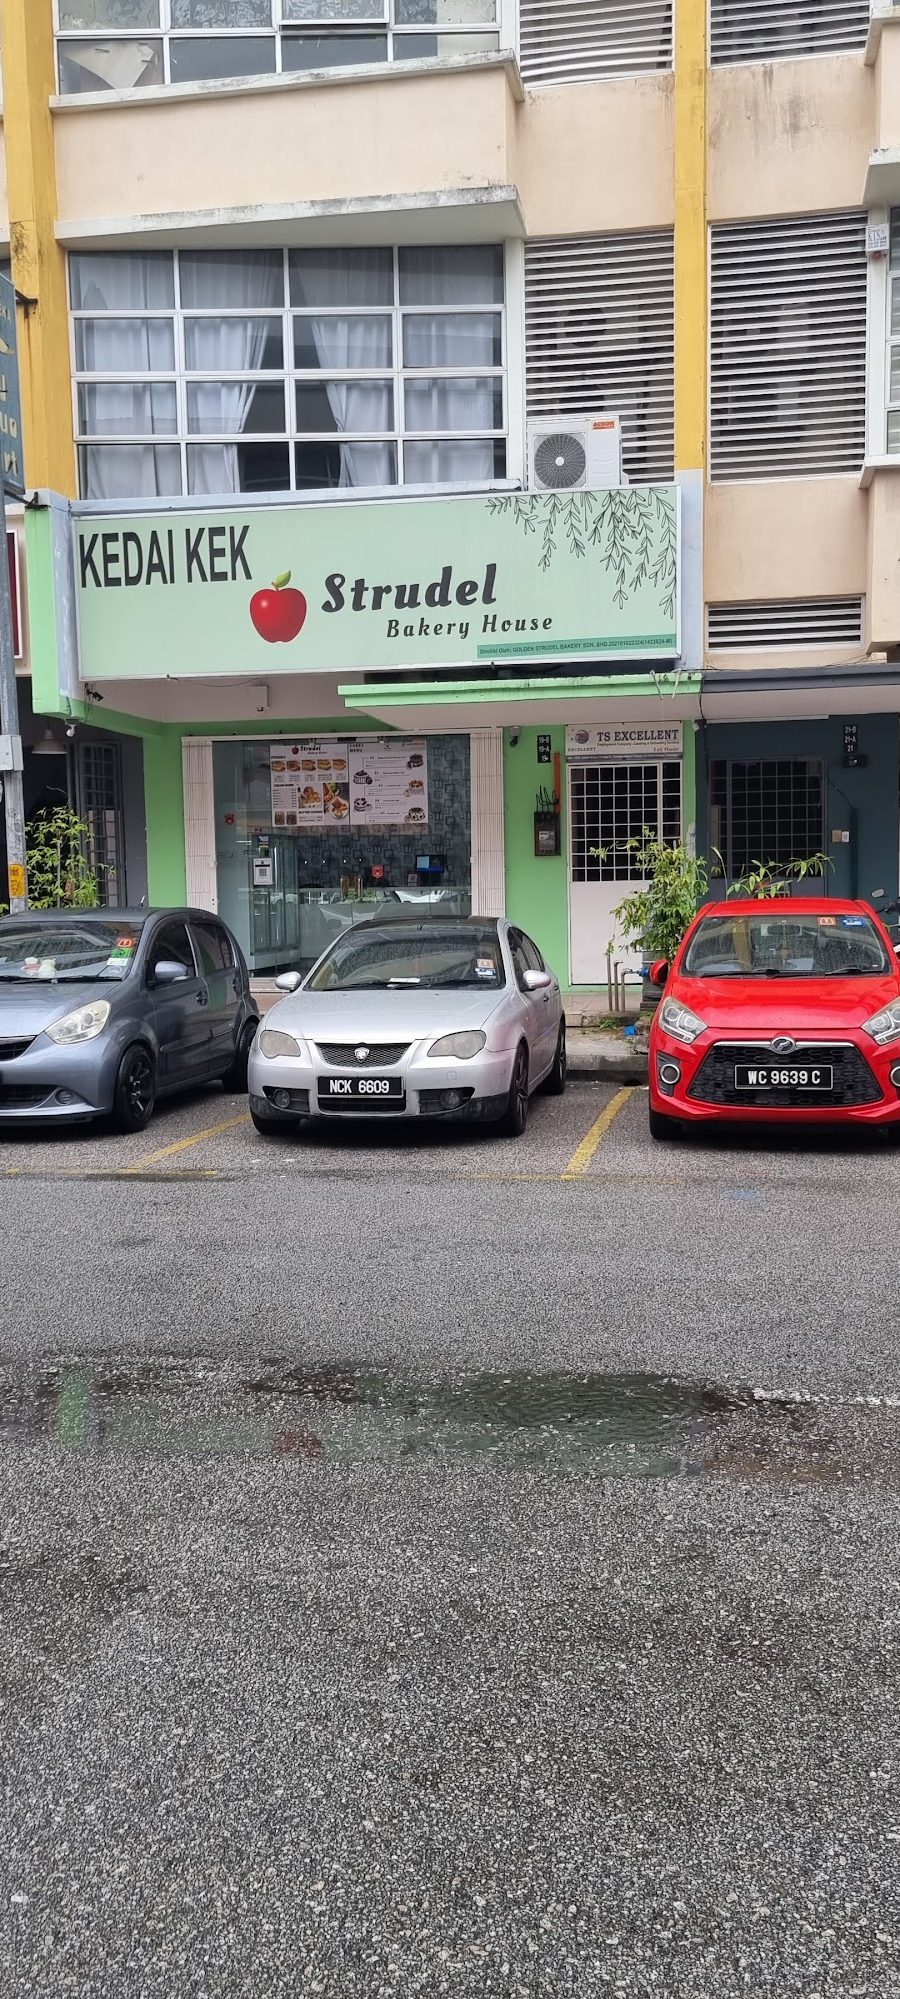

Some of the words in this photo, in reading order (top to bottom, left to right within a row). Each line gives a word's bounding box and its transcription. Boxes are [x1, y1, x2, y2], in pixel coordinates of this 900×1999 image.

[79, 529, 175, 588] KEDAI
[185, 525, 253, 583] KEK
[321, 563, 497, 613] Strudel
[386, 617, 470, 640] Bakery
[482, 614, 553, 633] House
[512, 645, 535, 653] GOLDEN
[535, 643, 559, 652] STRUDEL
[559, 642, 581, 650] BAKERY
[596, 731, 611, 742] TS
[614, 729, 679, 742] EXCELLENT
[847, 744, 854, 752] 21
[748, 1070, 767, 1085] WC
[770, 1070, 808, 1085] 9639
[811, 1070, 821, 1084] C
[329, 1079, 352, 1094] NCK
[358, 1080, 390, 1094] 6609
